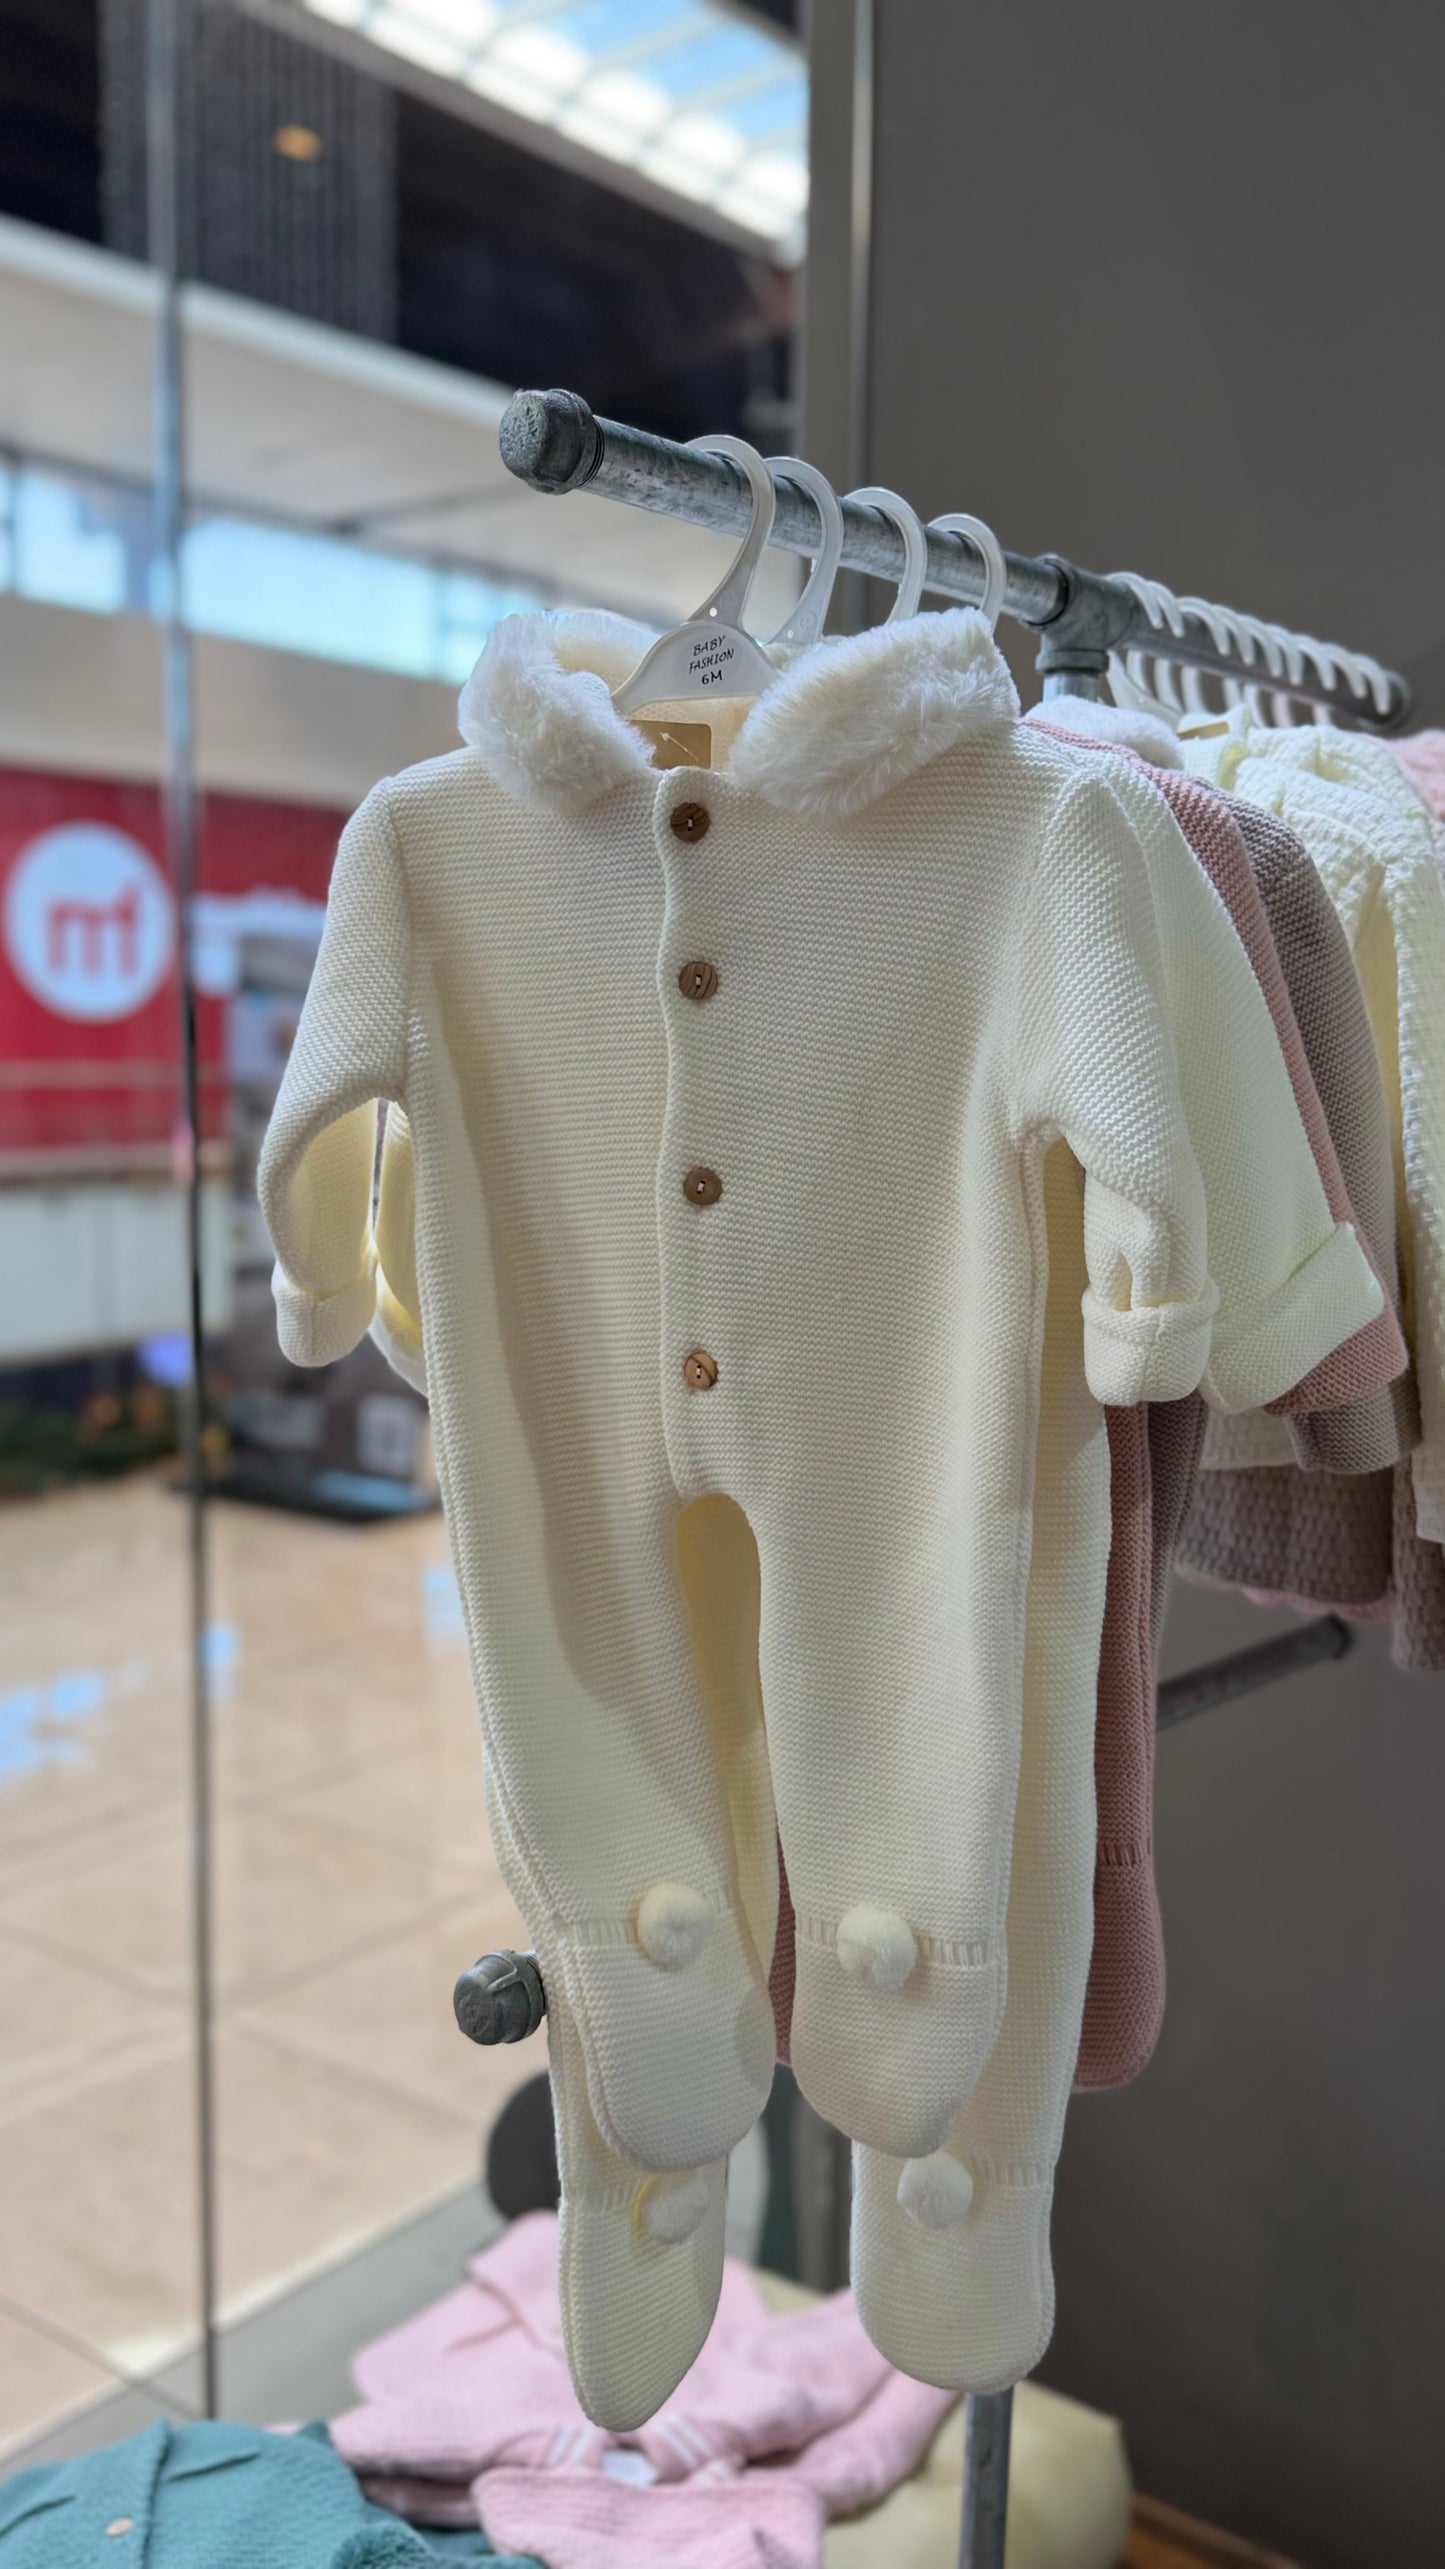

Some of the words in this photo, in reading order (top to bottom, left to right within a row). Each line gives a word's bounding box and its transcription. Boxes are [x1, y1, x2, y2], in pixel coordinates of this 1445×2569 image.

[693, 635, 726, 656] BABY
[689, 648, 734, 674] FASHION
[701, 669, 722, 685] 6M
